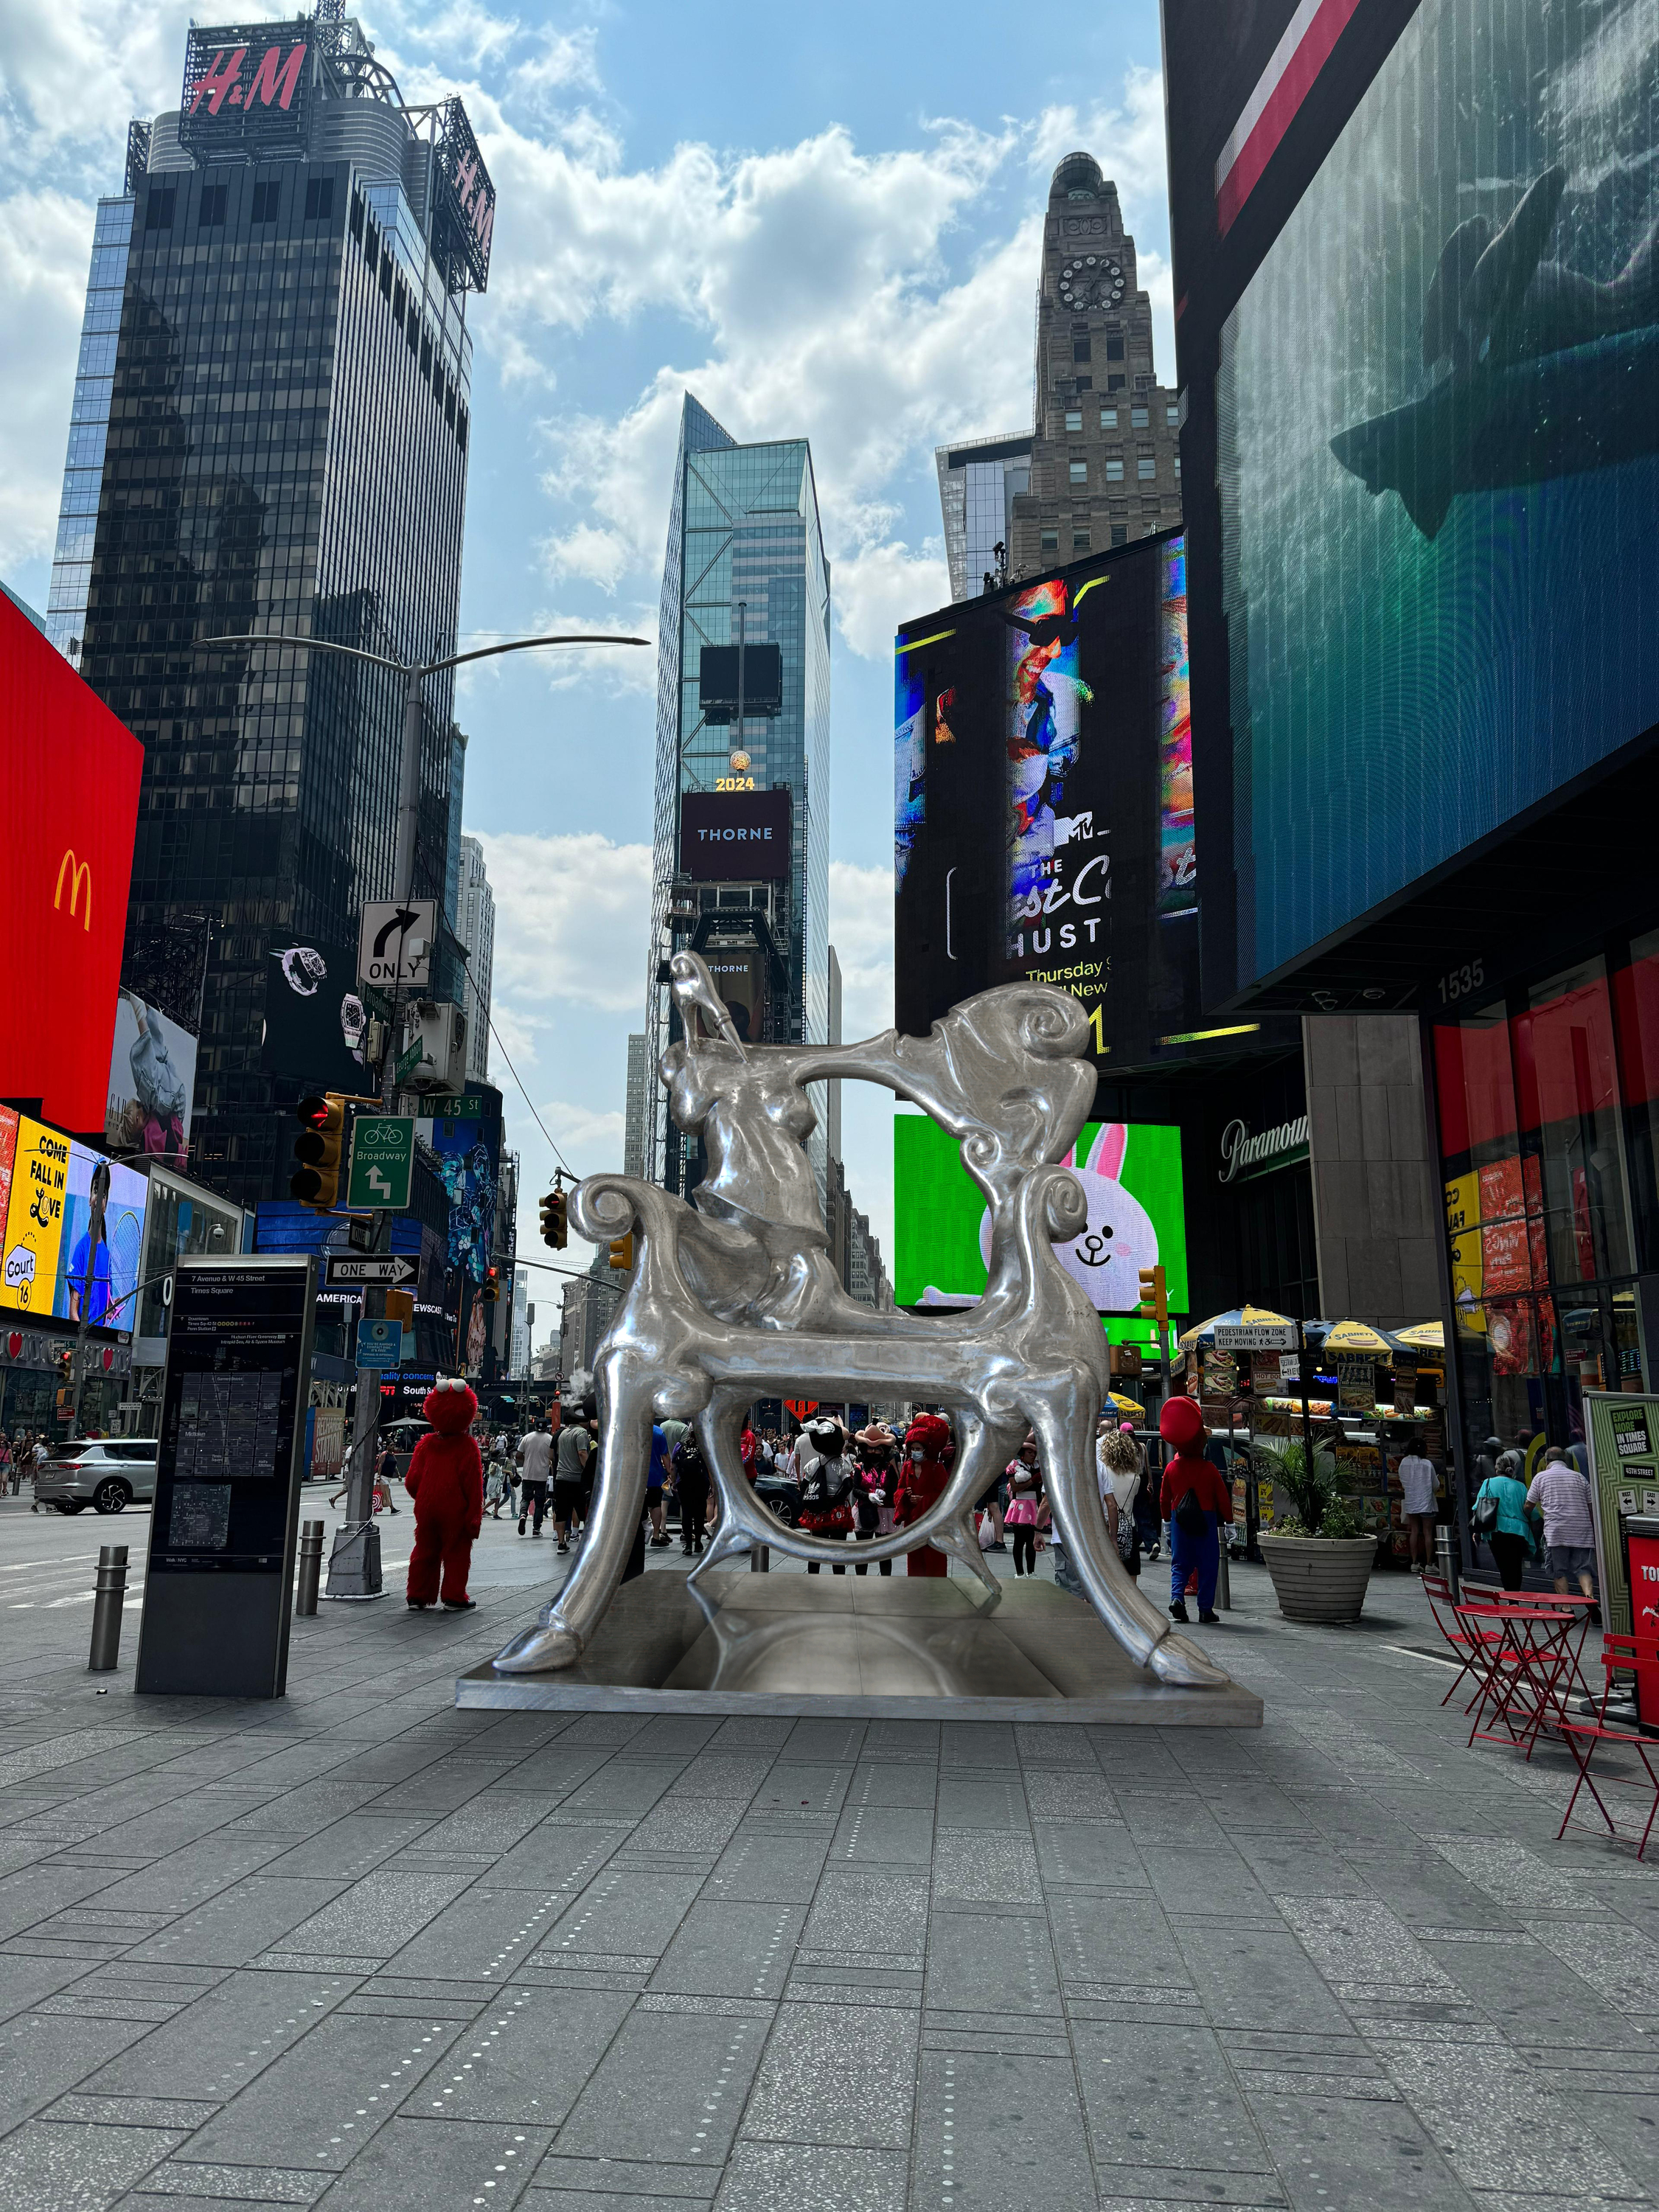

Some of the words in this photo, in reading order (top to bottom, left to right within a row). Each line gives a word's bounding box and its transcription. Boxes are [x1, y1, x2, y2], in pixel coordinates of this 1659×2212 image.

[189, 44, 307, 116] H&M
[454, 150, 494, 259] H&M
[715, 777, 755, 791] 2024
[698, 827, 773, 841] THORNE
[1029, 859, 1063, 878] THE
[1006, 917, 1102, 959] HUST
[369, 962, 418, 979] ONLY
[708, 964, 748, 973] THORNE
[1026, 961, 1103, 983] Thursday
[1438, 958, 1485, 1004] 1535
[1071, 981, 1108, 998] New
[423, 1099, 436, 1115] W
[444, 1099, 462, 1116] 45
[469, 1099, 479, 1110] St
[39, 1135, 68, 1164] COME
[357, 1151, 407, 1162] Broadway
[1218, 1115, 1310, 1182] Paramoun
[29, 1160, 52, 1187] FALL
[54, 1172, 64, 1191] IN
[29, 1187, 61, 1228] LOVE
[354, 1228, 366, 1244] ONE
[7, 1256, 34, 1279] Court
[340, 1265, 366, 1276] ONE
[379, 1264, 406, 1276] WAY
[20, 1284, 29, 1304] 16
[316, 1294, 363, 1304] AMERICA
[412, 1303, 442, 1317] EWSCAST
[1218, 1328, 1253, 1337] PEDESTRIAN
[1254, 1328, 1270, 1337] FLOW
[1271, 1328, 1287, 1336] ZONE
[1334, 1332, 1374, 1341] SABRETT
[1218, 1338, 1234, 1346] KEEP
[1234, 1338, 1256, 1346] MOVING
[1328, 1351, 1388, 1364] SABRETT
[403, 1373, 434, 1381] concerns
[403, 1385, 426, 1395] South
[1612, 1408, 1644, 1424] EXPLORE
[317, 1416, 344, 1438] RECHARGE
[1614, 1421, 1635, 1433] MORE
[1615, 1433, 1625, 1444] IN
[1624, 1430, 1646, 1444] TIMES
[315, 1430, 342, 1463] STATION
[1618, 1441, 1648, 1455] SQUARE
[1625, 1467, 1637, 1475] 45TH
[1637, 1468, 1654, 1476] STREET
